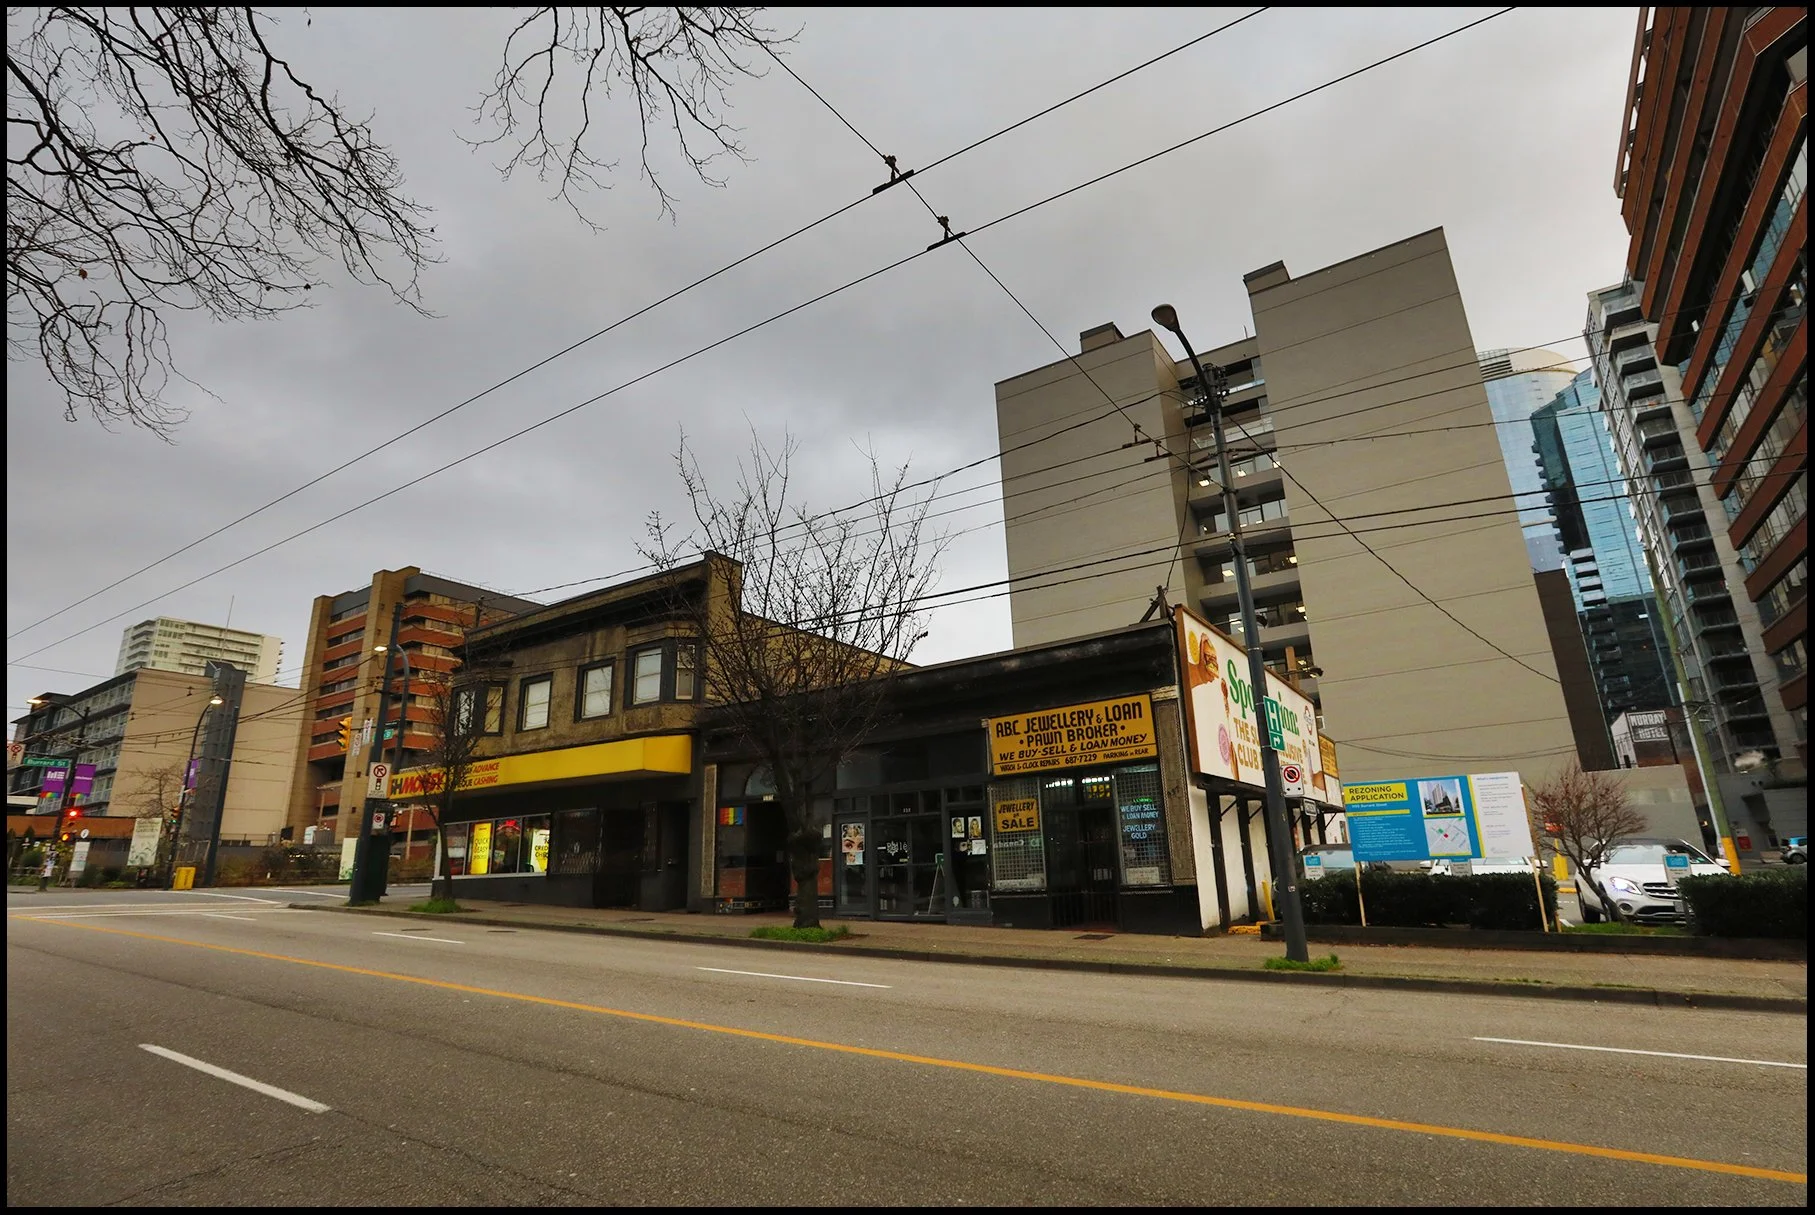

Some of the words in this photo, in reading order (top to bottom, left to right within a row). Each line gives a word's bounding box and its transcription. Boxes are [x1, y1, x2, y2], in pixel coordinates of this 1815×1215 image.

[1024, 708, 1094, 734] JEWELLERY
[1096, 714, 1103, 724] &
[1105, 701, 1143, 722] LOAN
[1629, 713, 1665, 726] MURRAY
[1026, 730, 1063, 748] PAWN
[1067, 723, 1118, 743] BROKER
[1233, 717, 1251, 743] THE
[1638, 727, 1668, 739] HOTEL
[1000, 752, 1015, 761] WE
[1069, 743, 1077, 753] &
[1081, 740, 1108, 751] LOAN
[1110, 733, 1147, 747] MONEY
[1022, 760, 1039, 769] CLOCK
[1039, 758, 1060, 767] REPAIRS
[1103, 750, 1129, 760] PARKING
[1134, 747, 1149, 756] REAR
[1237, 743, 1260, 771] CLUB
[473, 762, 499, 773] ADVANCE
[473, 775, 498, 787] CASHING
[1349, 785, 1392, 795] REZONING
[1350, 792, 1404, 802] APPLICATION
[998, 801, 1035, 814] JEWELLERY
[1120, 805, 1129, 813] WE
[1130, 804, 1142, 812] BUY
[1143, 803, 1157, 811] SELL
[1126, 812, 1140, 820] LOAN
[1141, 811, 1159, 819] MONEY
[1001, 817, 1035, 829] SALE
[1122, 824, 1156, 832] JEWELLERY
